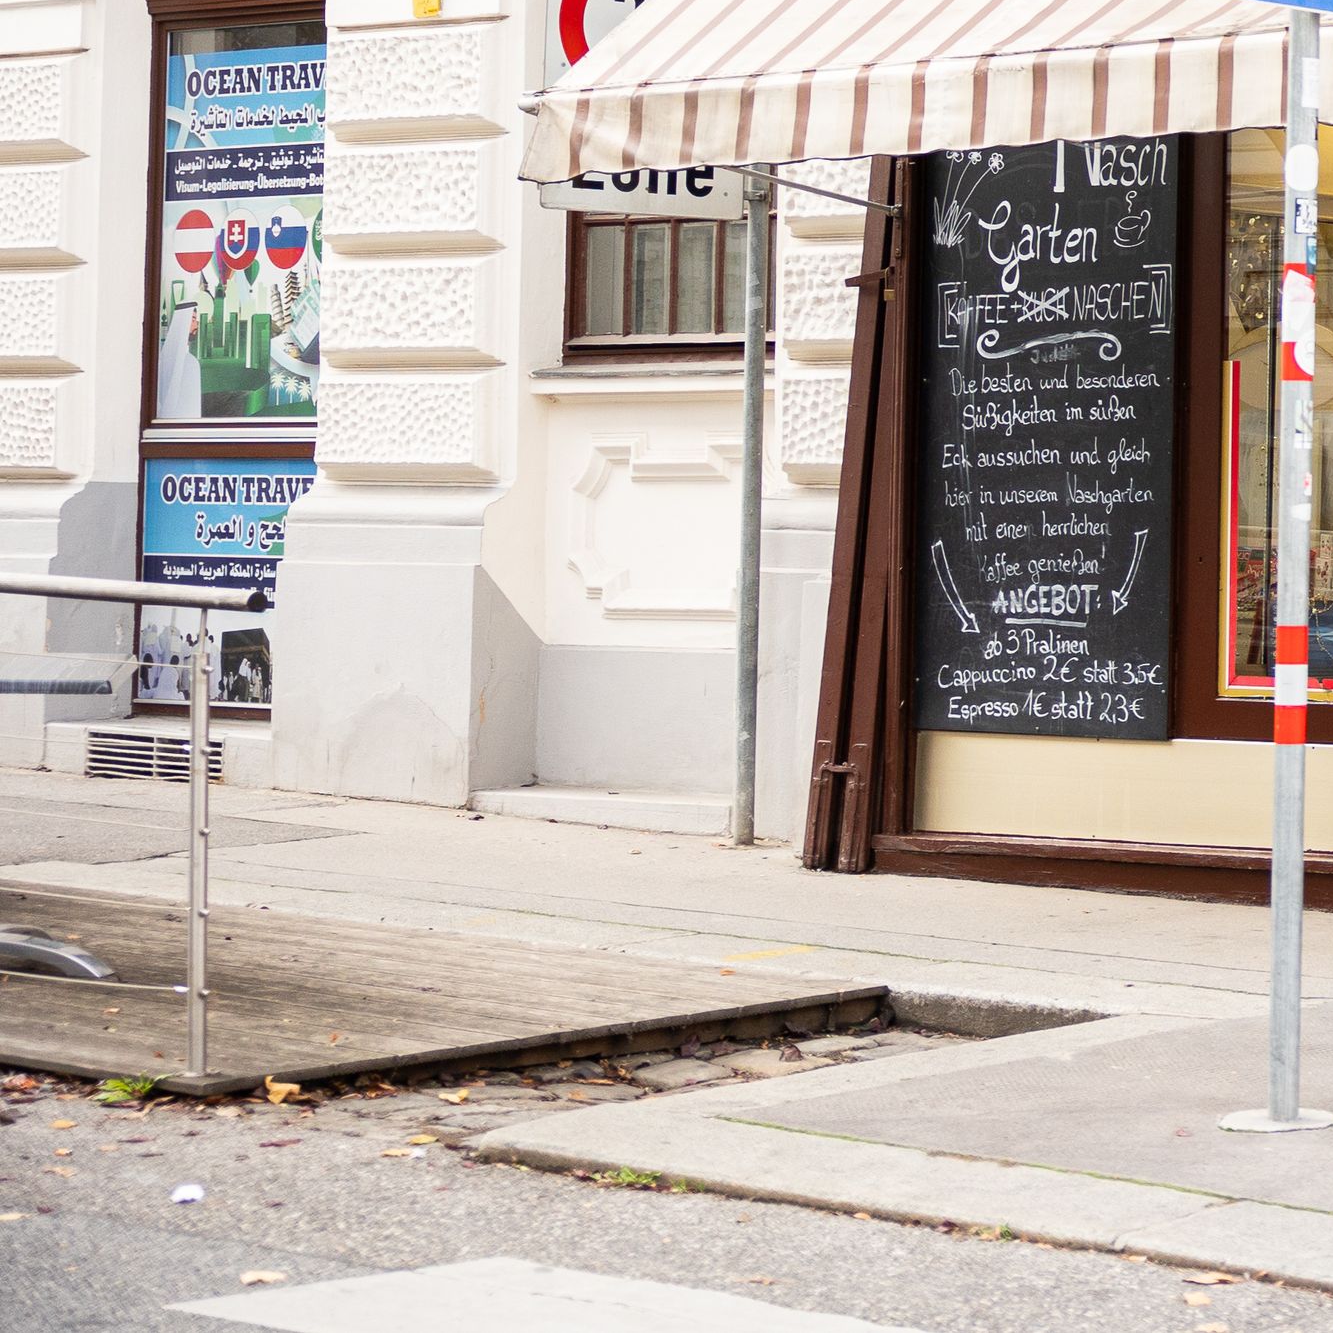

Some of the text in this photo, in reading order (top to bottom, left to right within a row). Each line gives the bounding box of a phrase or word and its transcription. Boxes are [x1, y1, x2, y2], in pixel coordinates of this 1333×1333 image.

[187, 61, 327, 98] OCEAN TRAV
[978, 201, 1098, 293] Garten
[1073, 277, 1164, 322] NASCHEN
[949, 362, 1160, 397] Die besten und besonderen
[962, 395, 1136, 436] Süßigkeiten im süßen
[942, 437, 1150, 474] Eck aussuchen und gleich
[162, 474, 238, 504] OCEAN
[945, 472, 1154, 514] hier in unserem Naschgarten
[195, 511, 242, 547] العمرة
[965, 512, 988, 541] mit
[1042, 511, 1112, 538] herrlichen
[978, 544, 1106, 584] Kaffee genießen!
[992, 584, 1101, 615] ANGEBOT:
[984, 628, 1090, 660] ab 3 Pralinen
[938, 663, 1036, 693] Cappuccino
[1043, 657, 1078, 683] 2€
[1083, 664, 1119, 685] statt
[948, 689, 1145, 725] Espresso 1€ statt 2,3€
